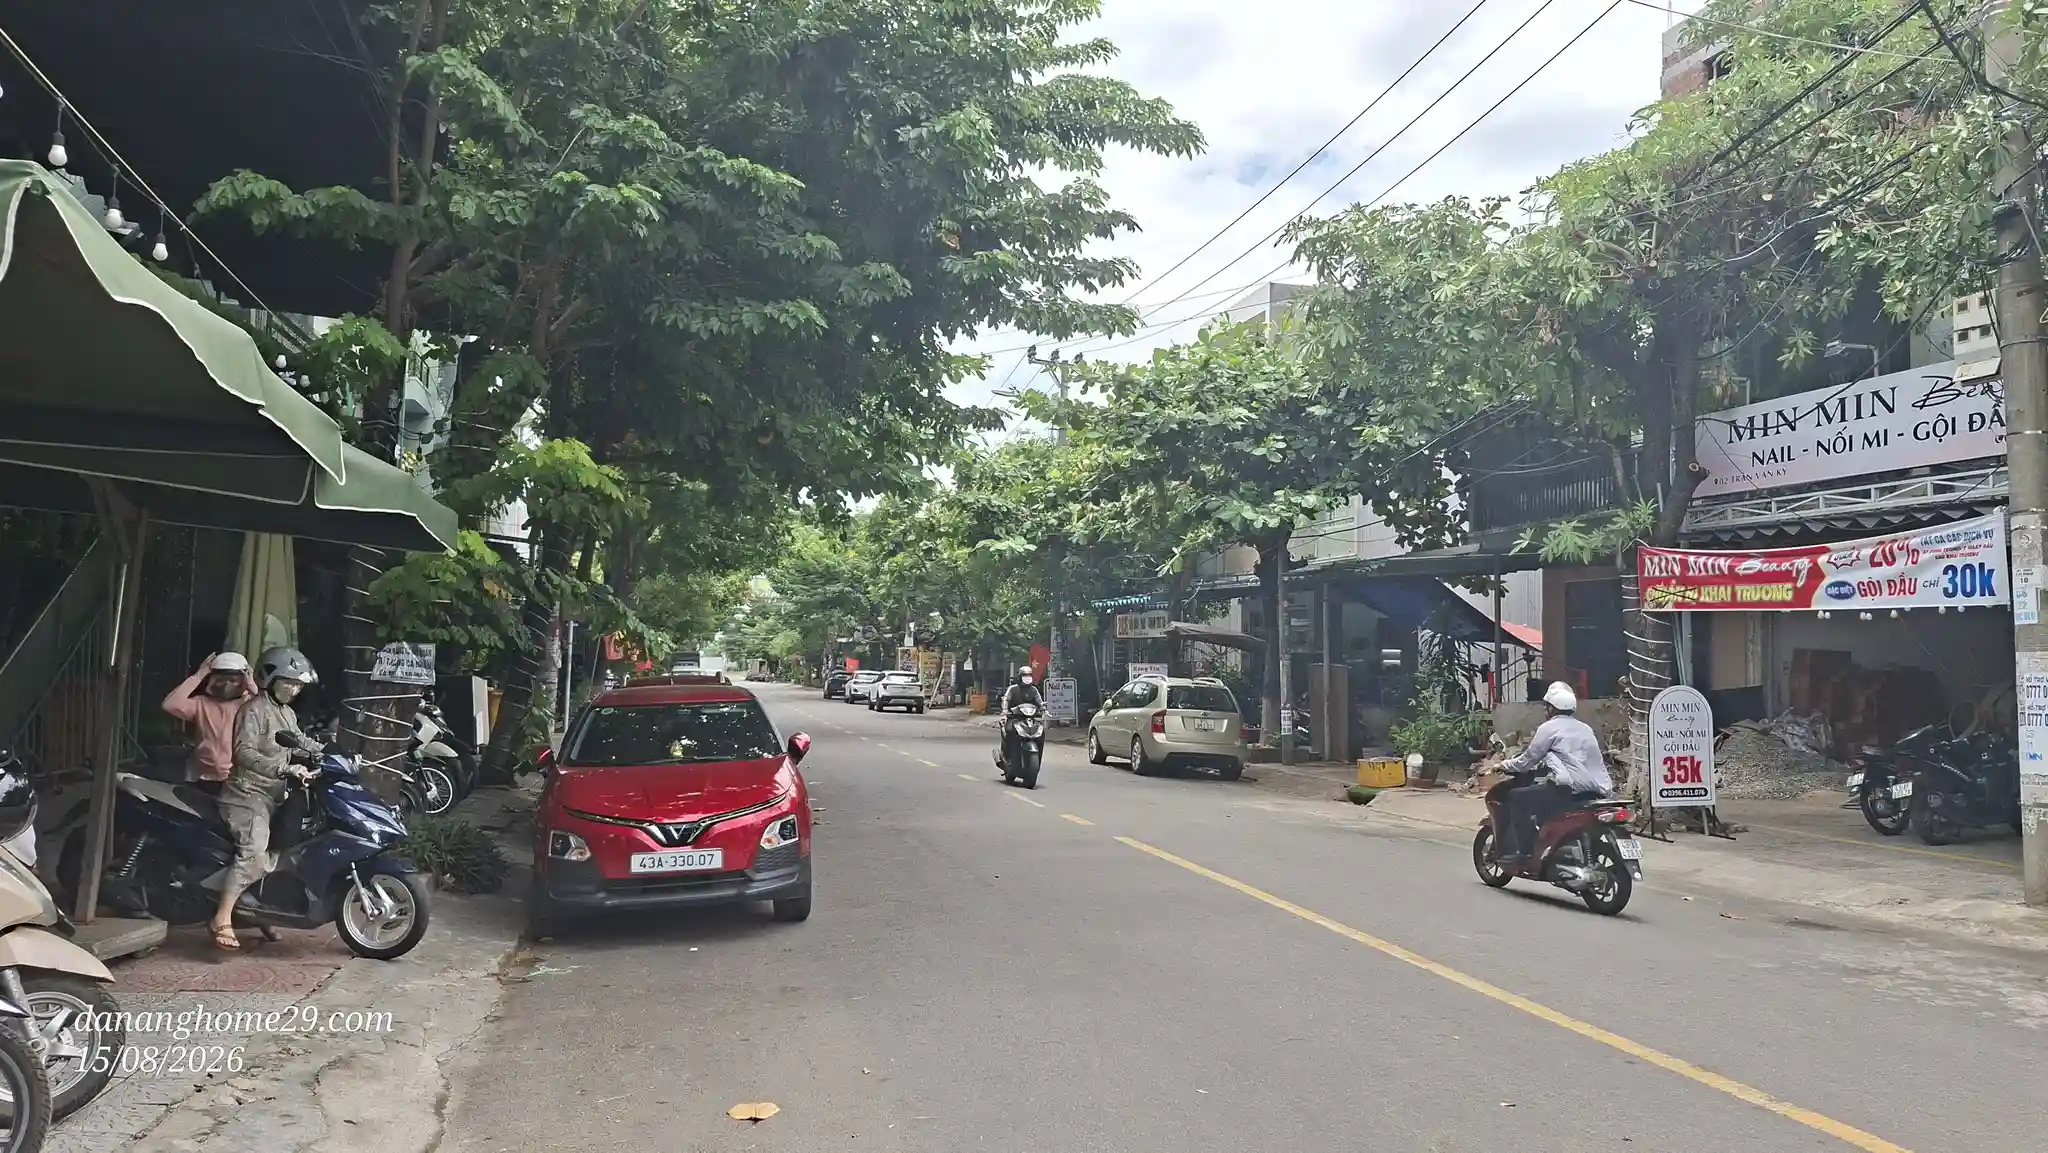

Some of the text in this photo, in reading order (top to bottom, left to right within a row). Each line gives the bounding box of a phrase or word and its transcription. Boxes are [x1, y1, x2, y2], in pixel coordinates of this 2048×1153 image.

[1727, 406, 1800, 444] MIN
[1814, 386, 1898, 428] MIN
[1751, 445, 1795, 467] NAIL
[1816, 426, 1853, 457] NỐI
[1862, 429, 1888, 450] MI
[1912, 412, 1956, 443] GỘI
[1869, 536, 1920, 568] 20%
[1644, 555, 1813, 587] MIN MIN Beauty
[1942, 562, 1997, 599] 30k
[1700, 585, 1731, 602] KHAI
[1857, 572, 1918, 601] GỘI ĐẦU
[1661, 702, 1700, 713] MIN MIN
[1656, 730, 1674, 739] NAIL
[1696, 730, 1706, 738] MI
[1663, 755, 1702, 784] 35k
[640, 854, 714, 869] 43A-330.07
